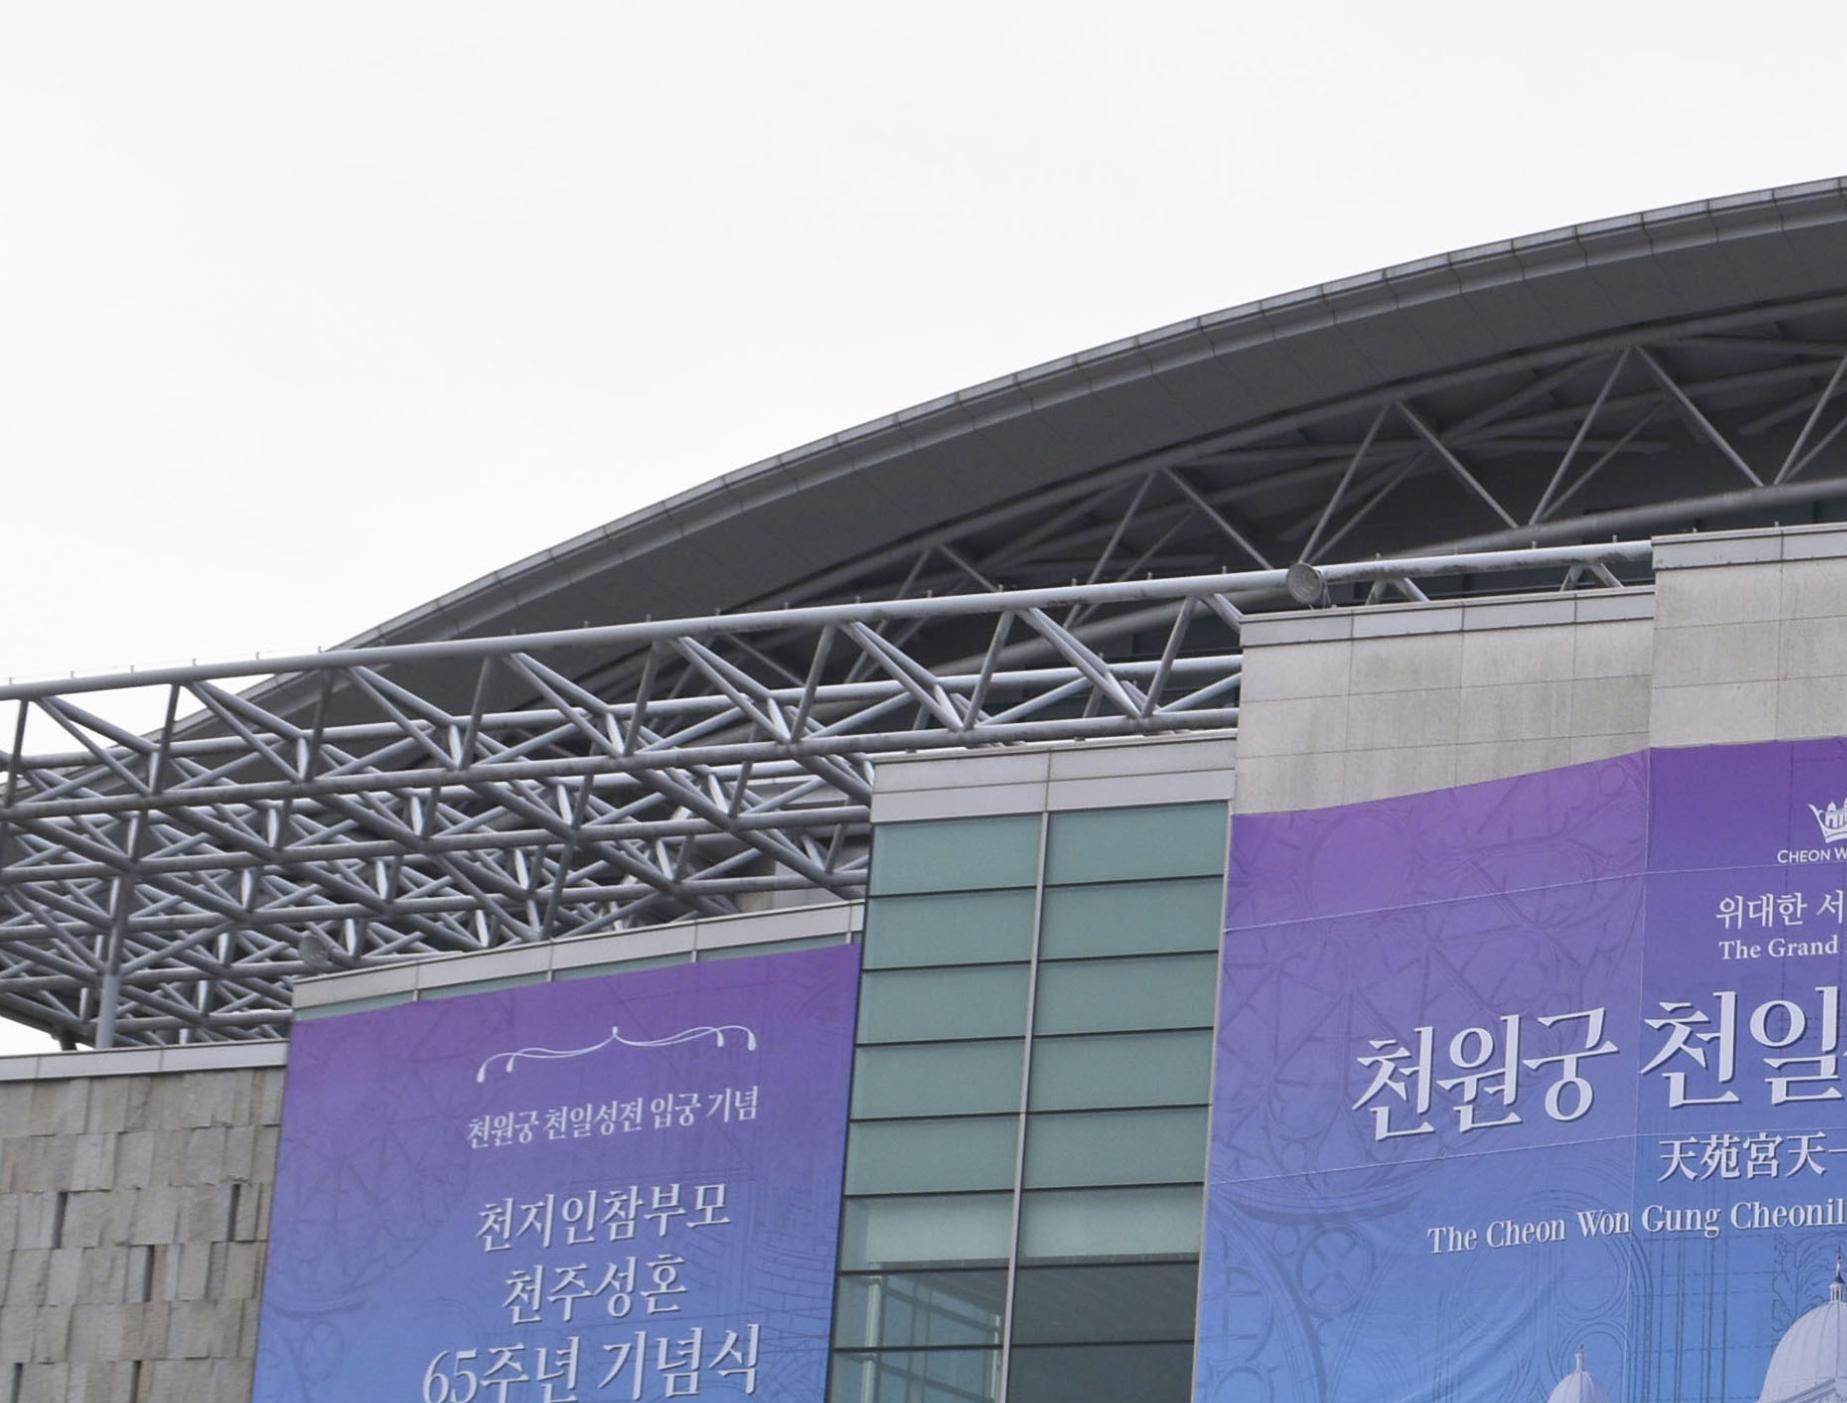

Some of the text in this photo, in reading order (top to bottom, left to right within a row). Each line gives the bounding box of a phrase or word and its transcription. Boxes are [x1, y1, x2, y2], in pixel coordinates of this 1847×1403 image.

[1776, 849, 1831, 864] CHEON
[1716, 892, 1808, 929] 위대한
[1718, 939, 1761, 960] The
[1767, 934, 1838, 958] Grand
[1351, 1007, 1619, 1141] 천원궁
[468, 1085, 759, 1149] 천원궁 천일성전 입궁 기념
[476, 1183, 731, 1252] 천지인참부모
[1427, 1226, 1477, 1253] The
[1486, 1219, 1565, 1248] Cheon
[1576, 1209, 1630, 1237] Won
[1641, 1204, 1721, 1238] Gung
[1730, 1197, 1844, 1229] Cheonil
[502, 1254, 687, 1324] 천주성혼
[598, 1323, 759, 1400] 기념식
